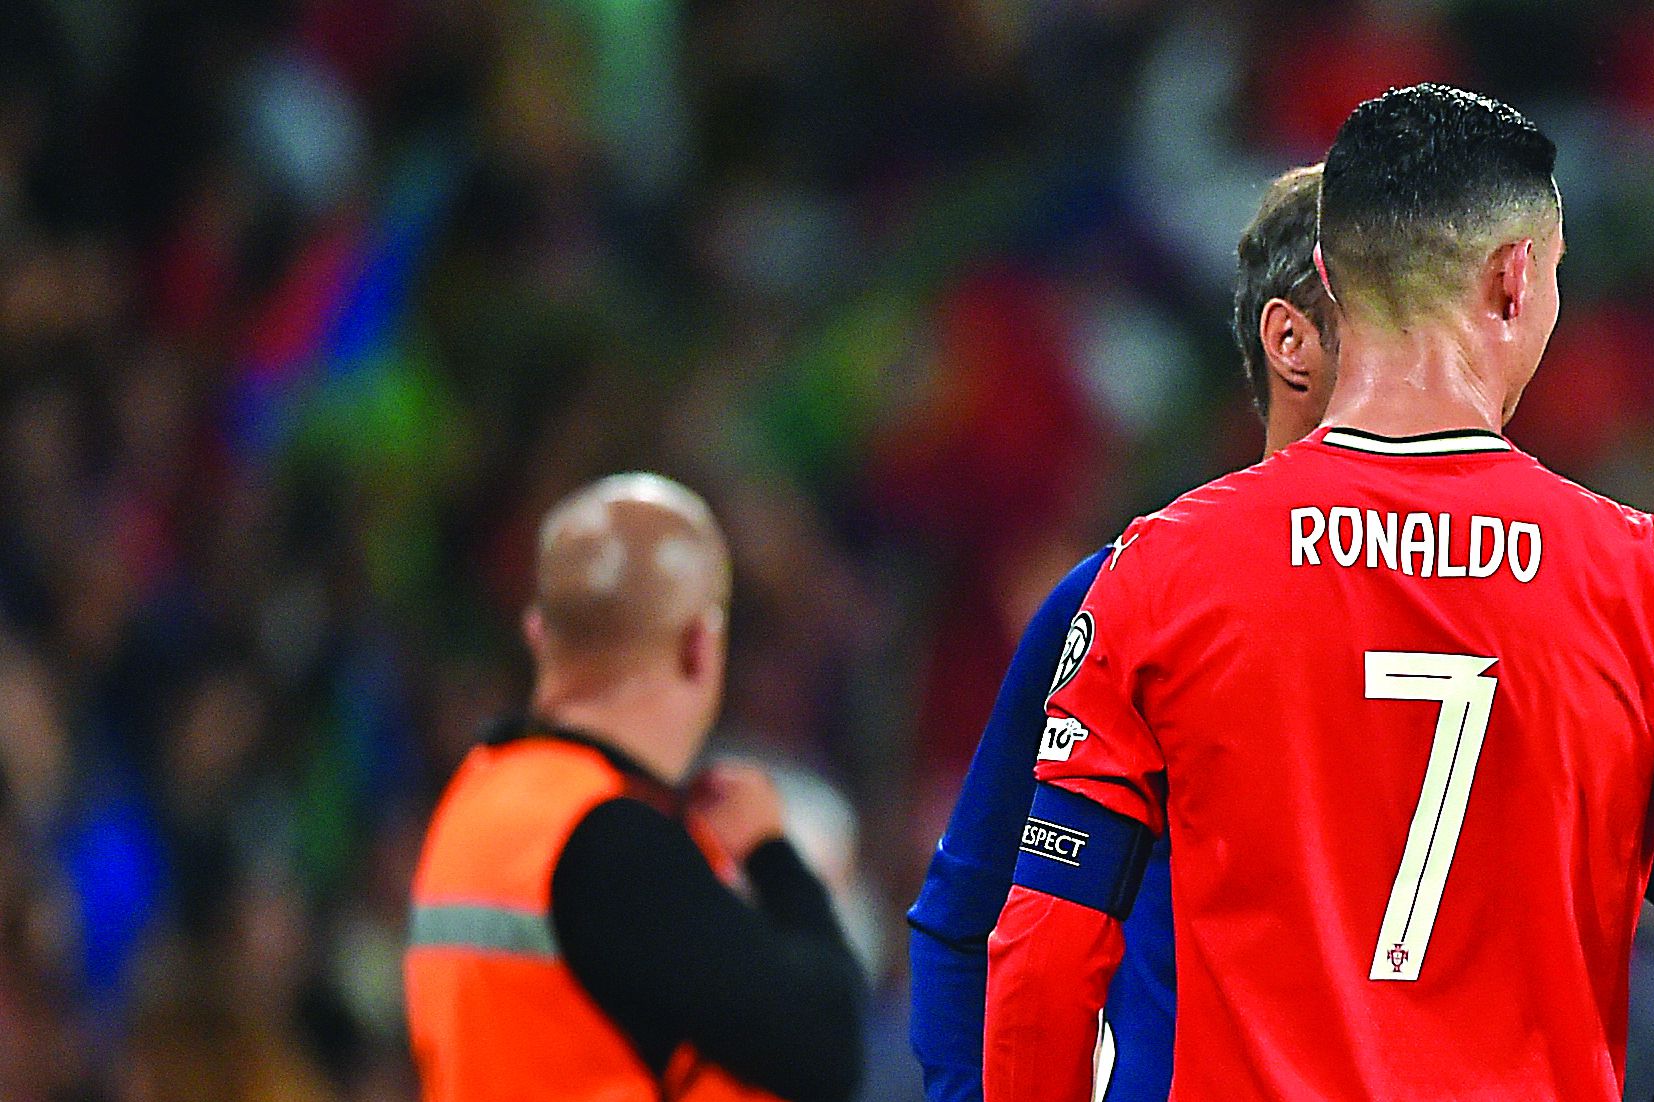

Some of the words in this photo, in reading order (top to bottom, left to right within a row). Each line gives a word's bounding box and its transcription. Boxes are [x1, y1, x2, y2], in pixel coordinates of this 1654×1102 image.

[1290, 506, 1542, 583] RONALDO
[1020, 824, 1086, 859] ESPECT
[1364, 651, 1500, 981] 7
